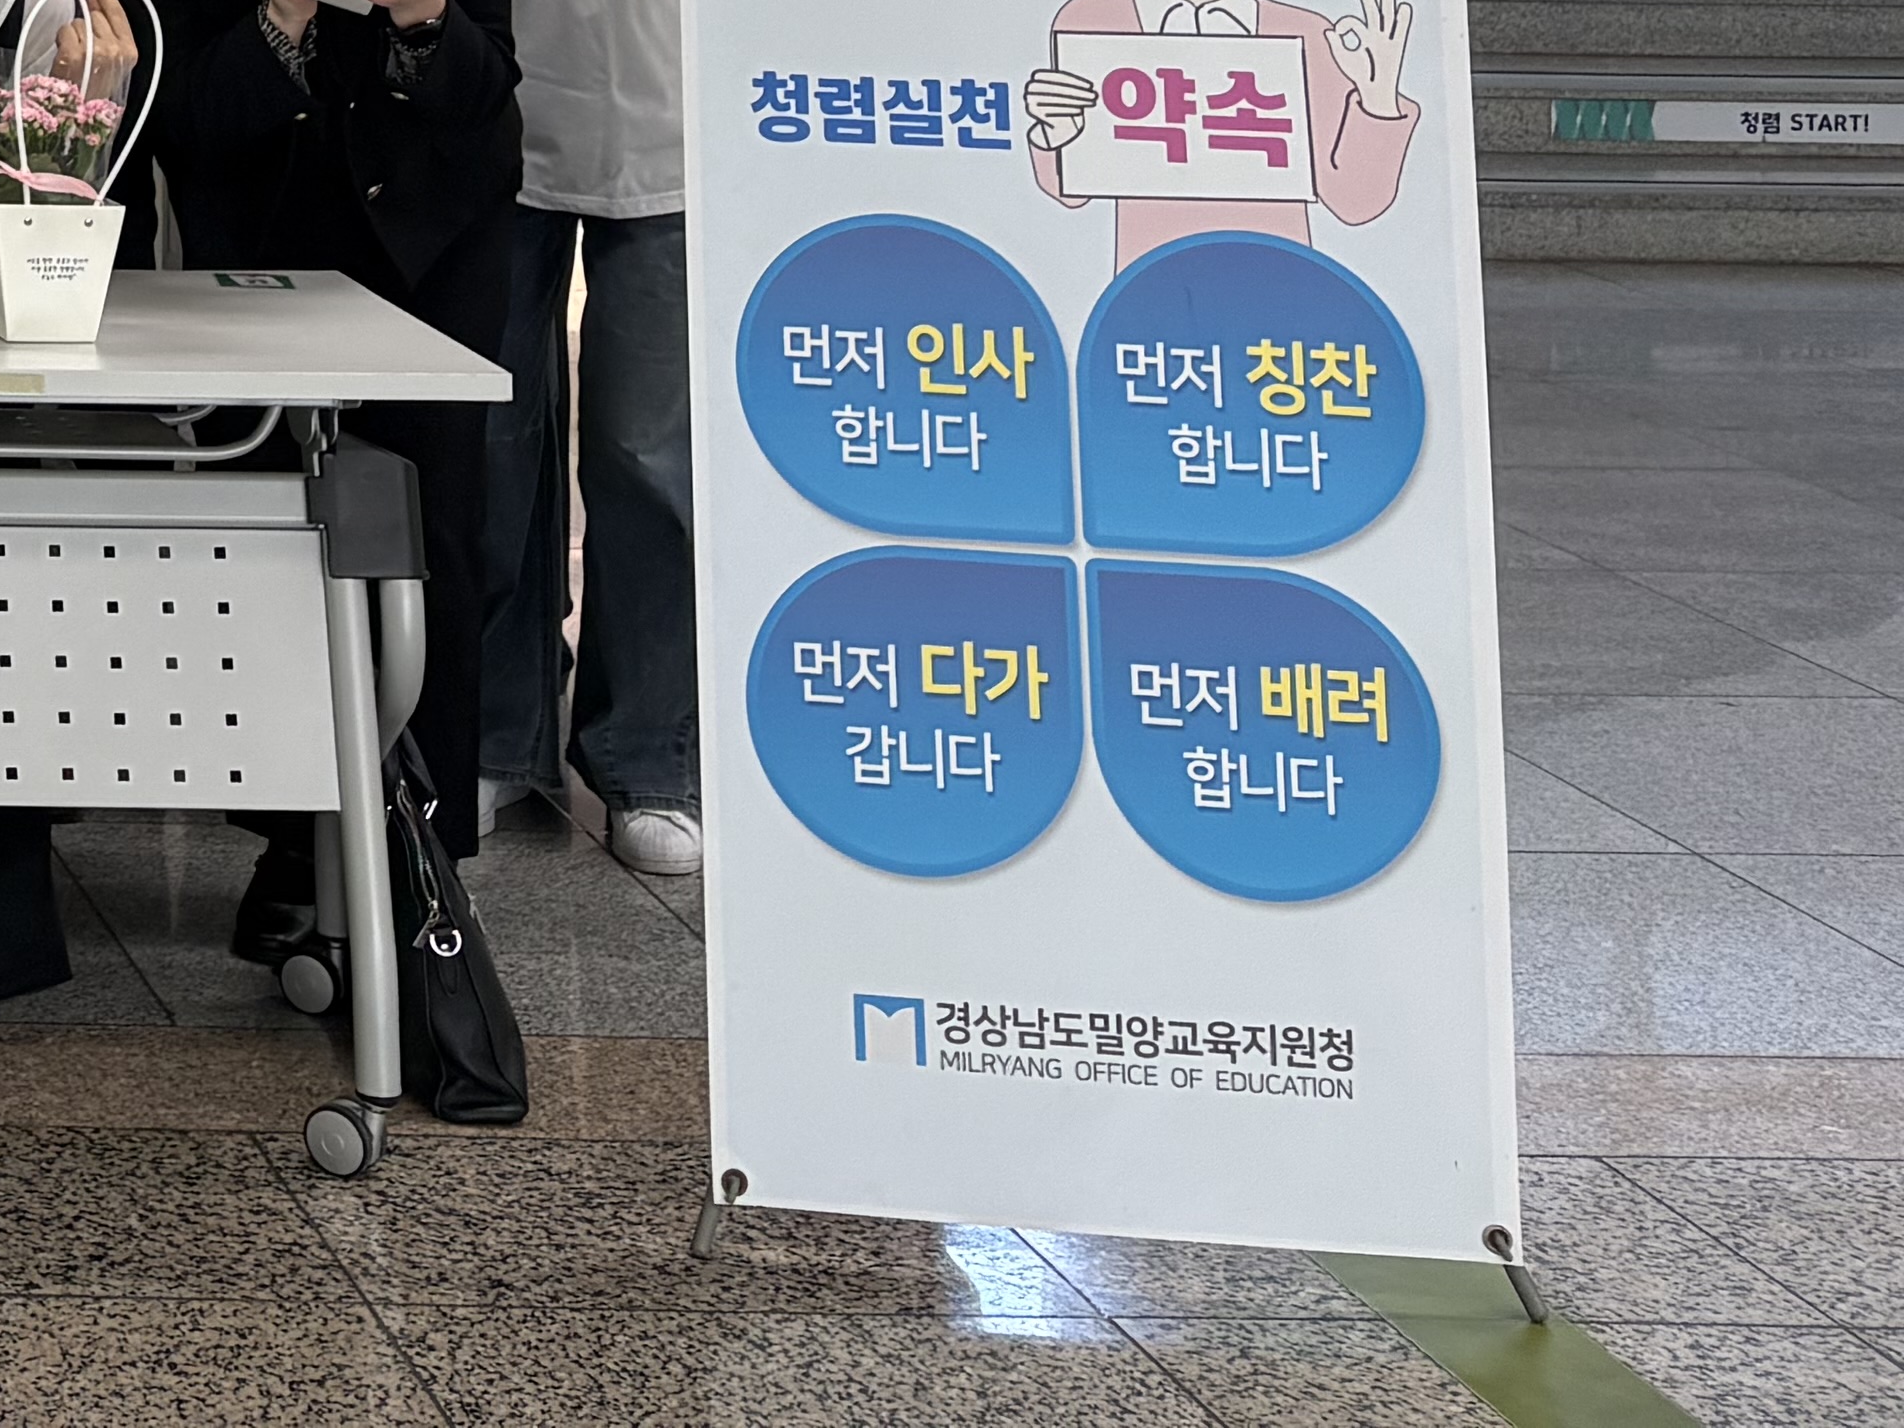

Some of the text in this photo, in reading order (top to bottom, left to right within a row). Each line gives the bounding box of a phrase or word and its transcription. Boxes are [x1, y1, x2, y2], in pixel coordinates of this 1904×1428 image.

[751, 67, 1293, 168] 청렴실천 약속
[1739, 111, 1870, 135] 청렴 START!
[782, 323, 1034, 399] 먼저 인사
[1115, 338, 1376, 418] 먼저 칭찬
[832, 404, 987, 470] 합니다
[1167, 423, 1328, 490] 합니다
[793, 641, 1049, 720] 먼저 다가
[1130, 662, 1389, 743] 먼저 배려
[846, 726, 1001, 793] 갑니다
[1183, 746, 1343, 815] 합니다
[936, 1002, 1354, 1072] 경상남도밀양교육지원청
[940, 1050, 1353, 1100] MILRYANG OFFICE OF EDUCATION
